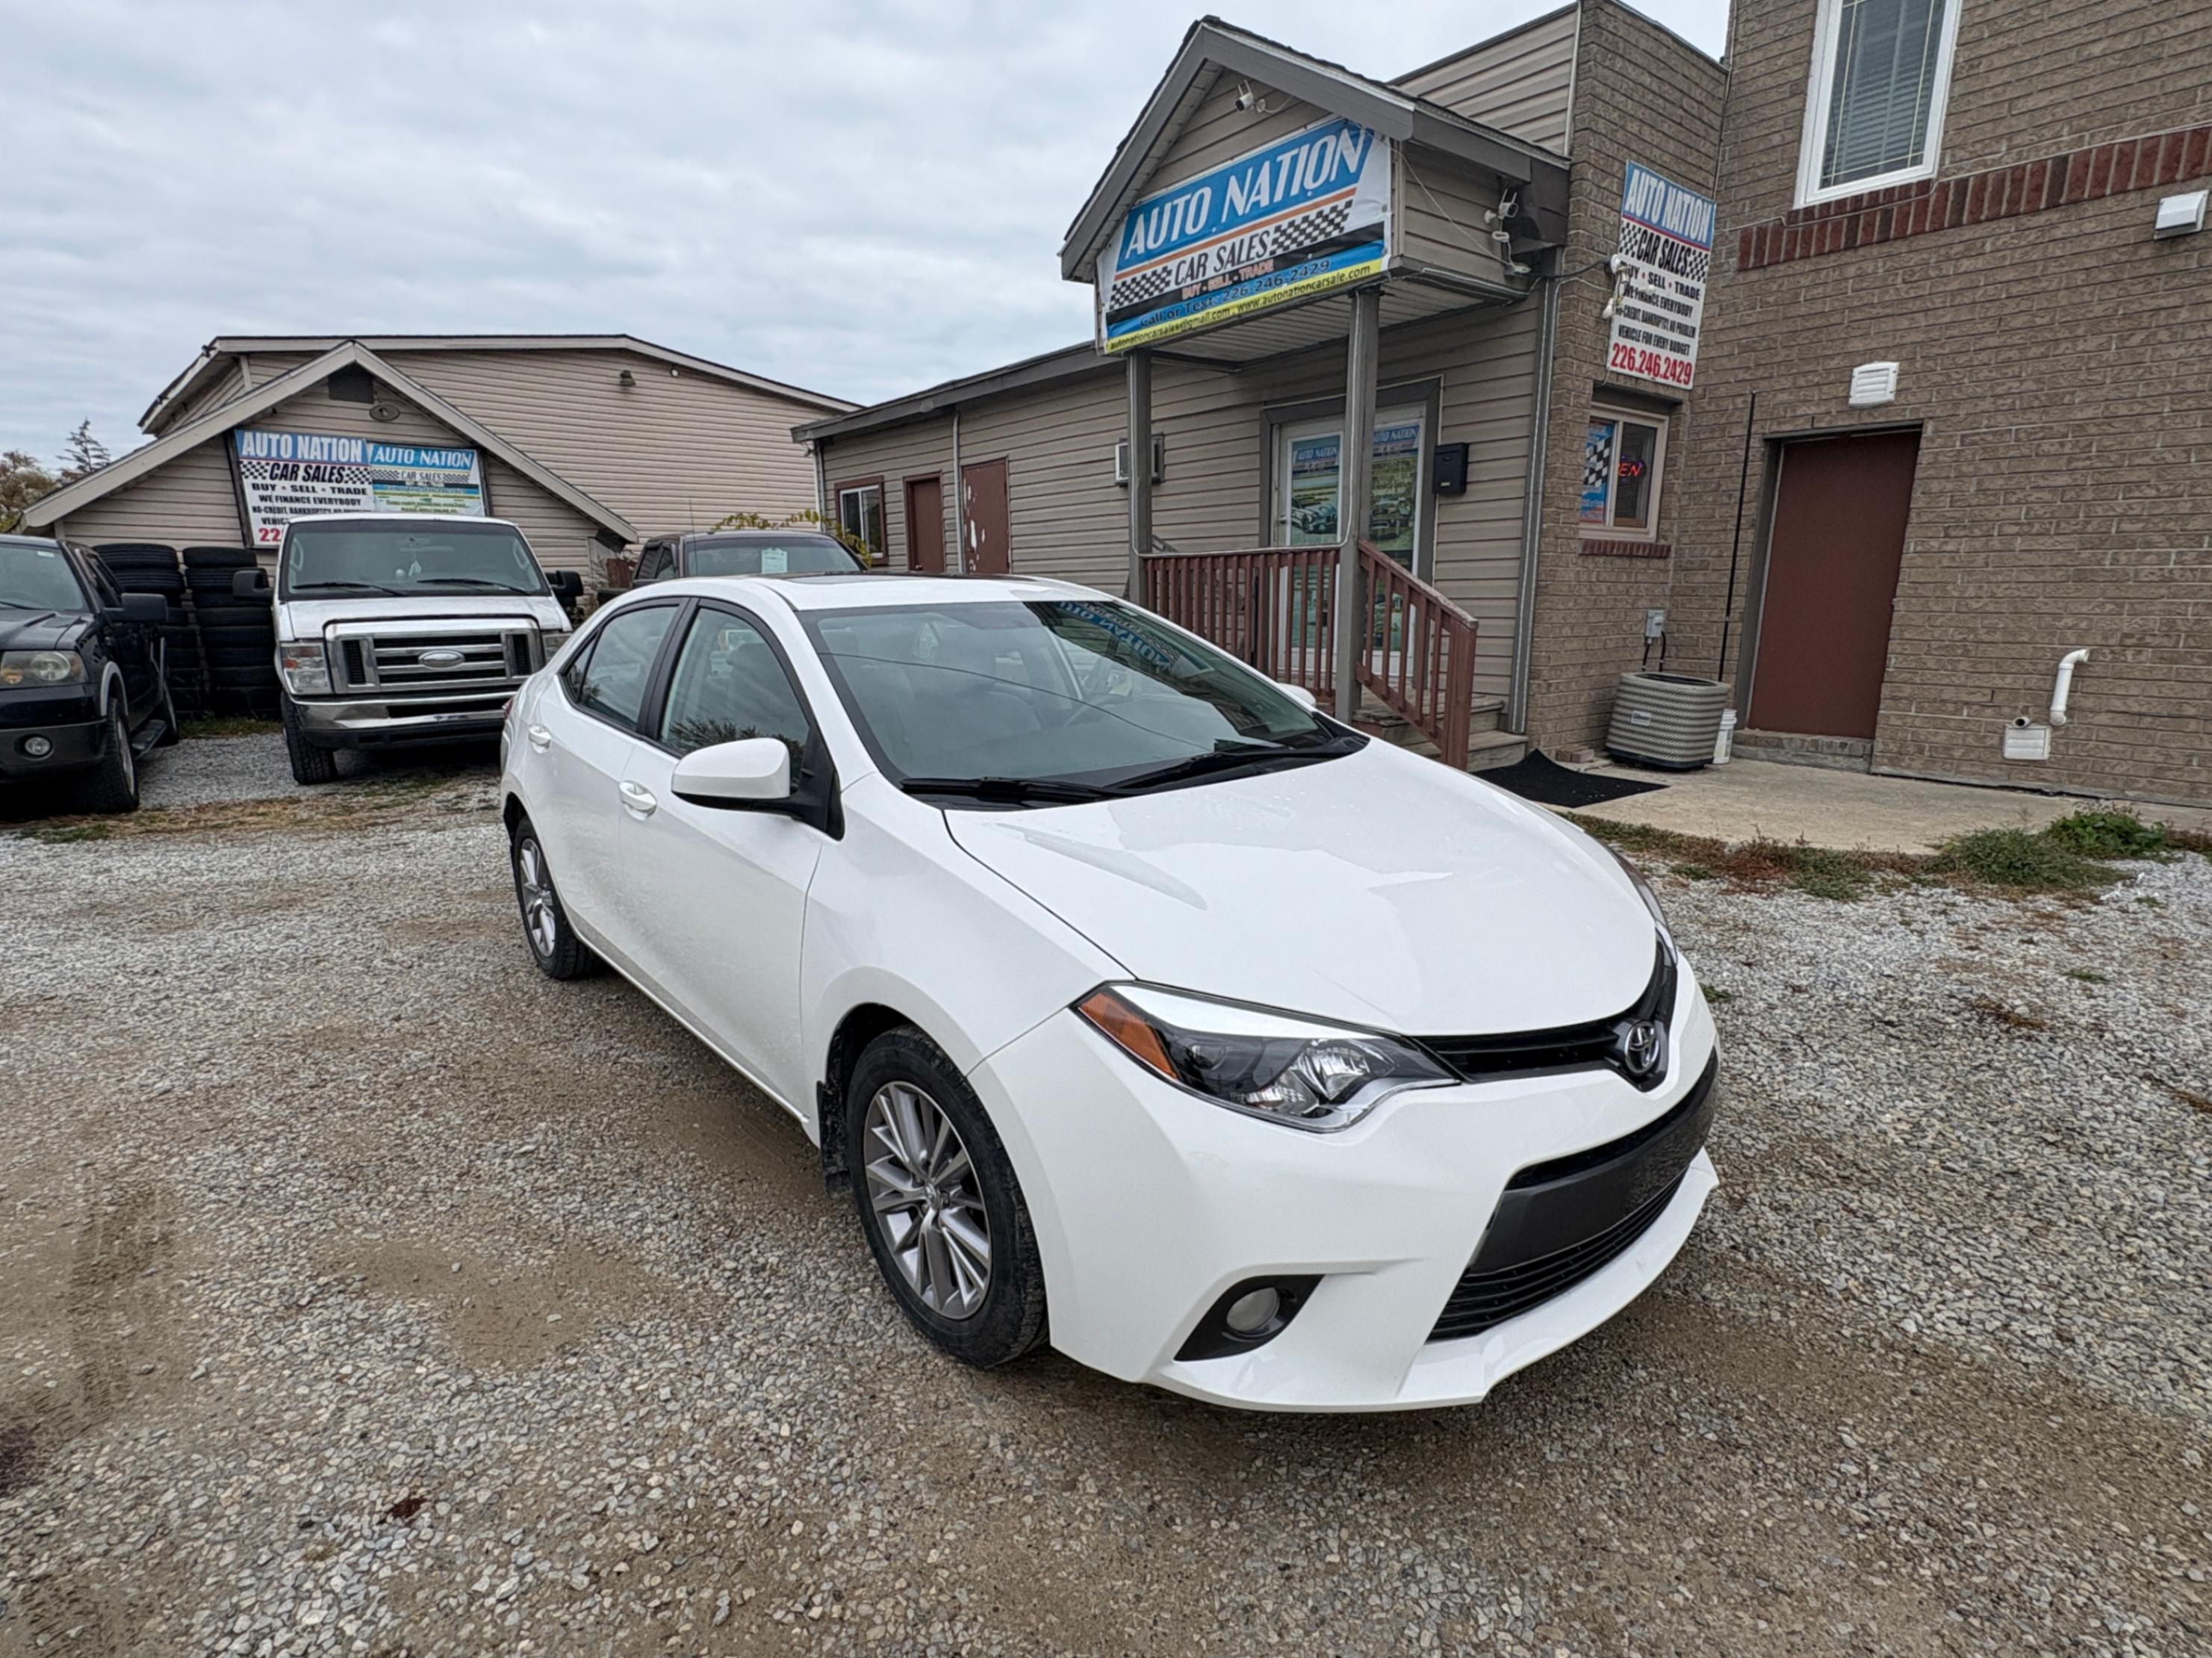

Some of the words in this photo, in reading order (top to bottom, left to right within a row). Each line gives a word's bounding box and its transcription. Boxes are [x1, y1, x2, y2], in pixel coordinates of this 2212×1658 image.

[1125, 186, 1211, 259] AUTO
[1222, 128, 1365, 223] NATION
[1624, 169, 1665, 223] AUTO
[1662, 186, 1712, 243] NATION
[1174, 256, 1207, 286] CAR
[1214, 229, 1270, 273] SALES
[1637, 231, 1659, 264] CAR
[1659, 238, 1691, 277] SALES
[1141, 311, 1163, 327] Call
[1166, 308, 1179, 320] or
[1222, 259, 1329, 302] 226-246-2429
[1182, 283, 1202, 299] BUY
[1208, 275, 1231, 290] SELL
[1239, 260, 1274, 281] TRADE
[1648, 271, 1666, 290] SELL
[1674, 280, 1700, 300] TRADE
[1660, 296, 1693, 318] EVERYBODY
[1618, 324, 1641, 342] VEHICLE
[1641, 331, 1653, 345] FOR
[1653, 334, 1669, 350] EVERY
[1668, 339, 1691, 356] BUDGET
[1611, 343, 1692, 385] 226.246.2429
[242, 431, 293, 459] AUTO
[297, 435, 362, 463] NATION
[374, 446, 415, 464] AUTO
[420, 450, 472, 468] NATION
[252, 482, 276, 491] BUY
[291, 485, 317, 494] SELL
[329, 487, 367, 496] TRADE
[269, 462, 301, 482] CAR
[302, 465, 346, 484] SALES
[401, 471, 416, 480] CAR
[420, 472, 442, 482] SALES
[259, 494, 273, 503] WE
[275, 495, 311, 504] FINANCE
[313, 497, 361, 506] EVERYBODY
